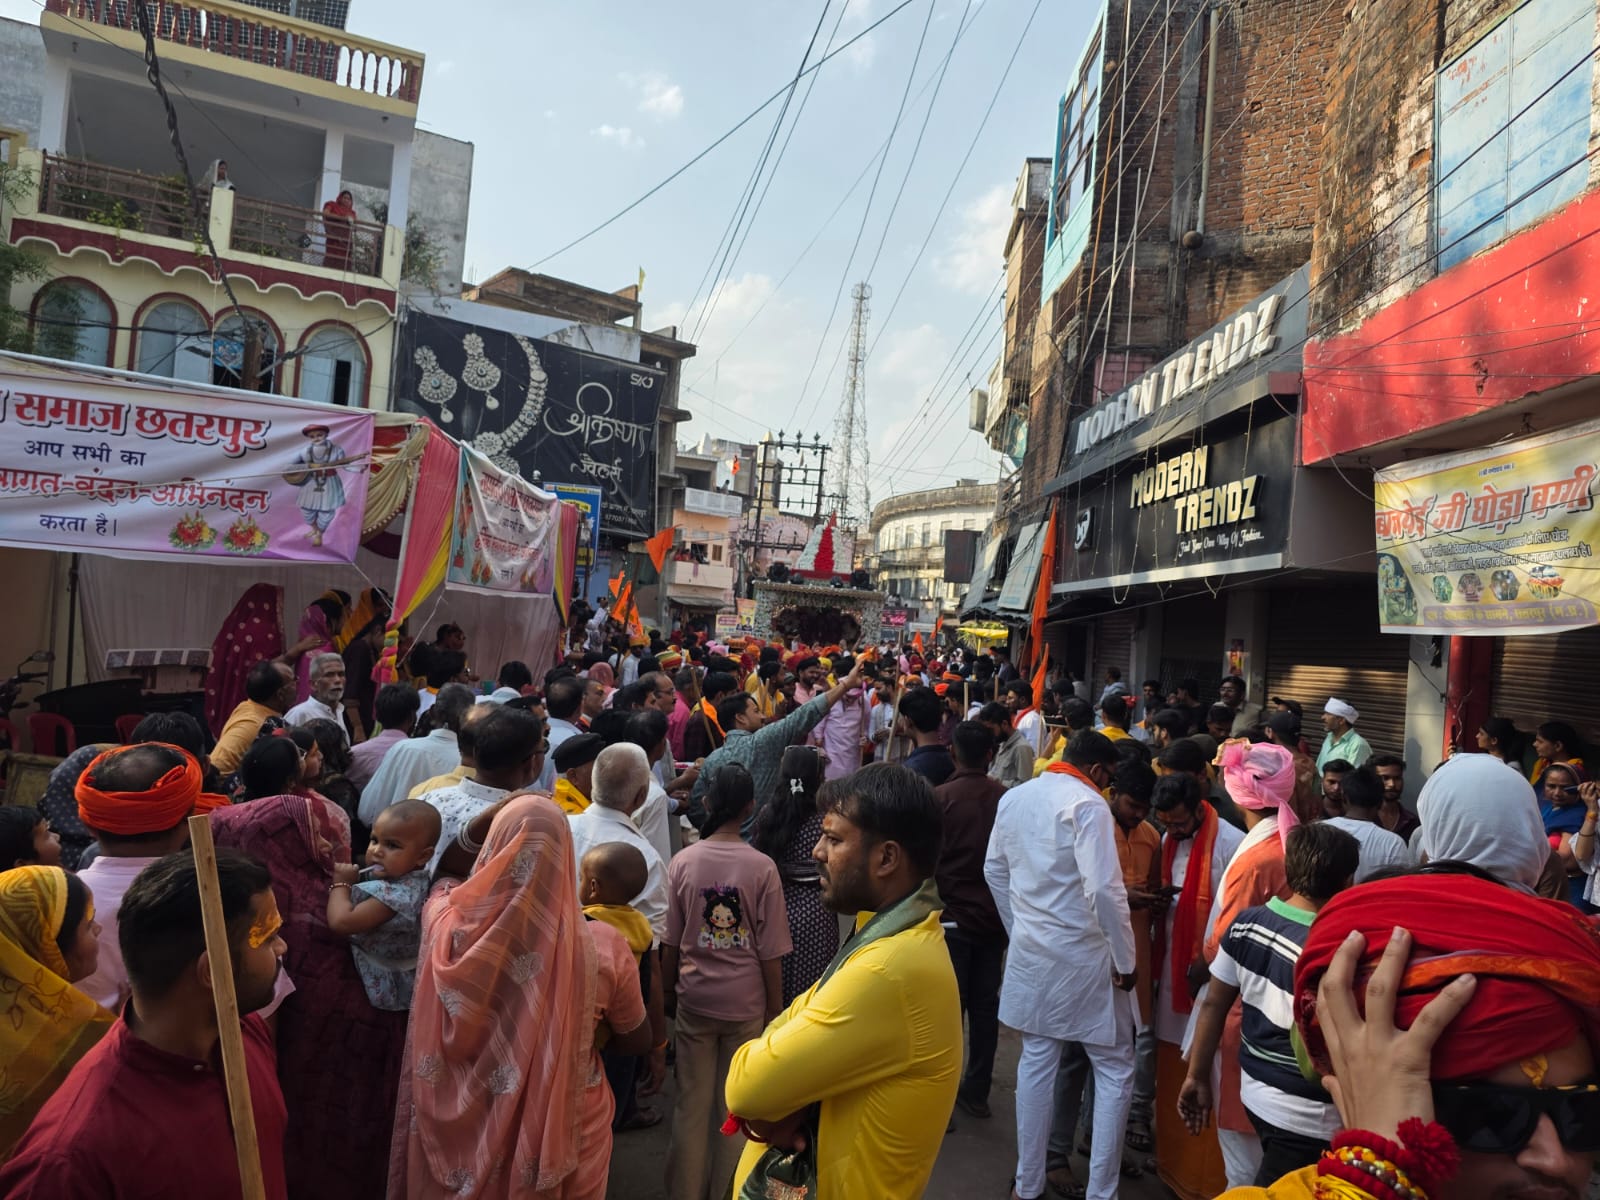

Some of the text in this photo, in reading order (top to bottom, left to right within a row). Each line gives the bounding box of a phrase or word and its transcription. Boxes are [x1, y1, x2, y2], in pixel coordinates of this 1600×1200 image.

[1075, 294, 1281, 454] MODERN TRENDZ
[14, 391, 126, 430] समाज
[135, 405, 266, 454] छतरपुर
[24, 440, 147, 466] आप सभी का
[1130, 445, 1208, 508] MODERN
[40, 512, 117, 536] करता है।
[1174, 475, 1259, 534] TRENDZ
[1433, 492, 1469, 530] जी
[1472, 485, 1526, 530] घोड़ा
